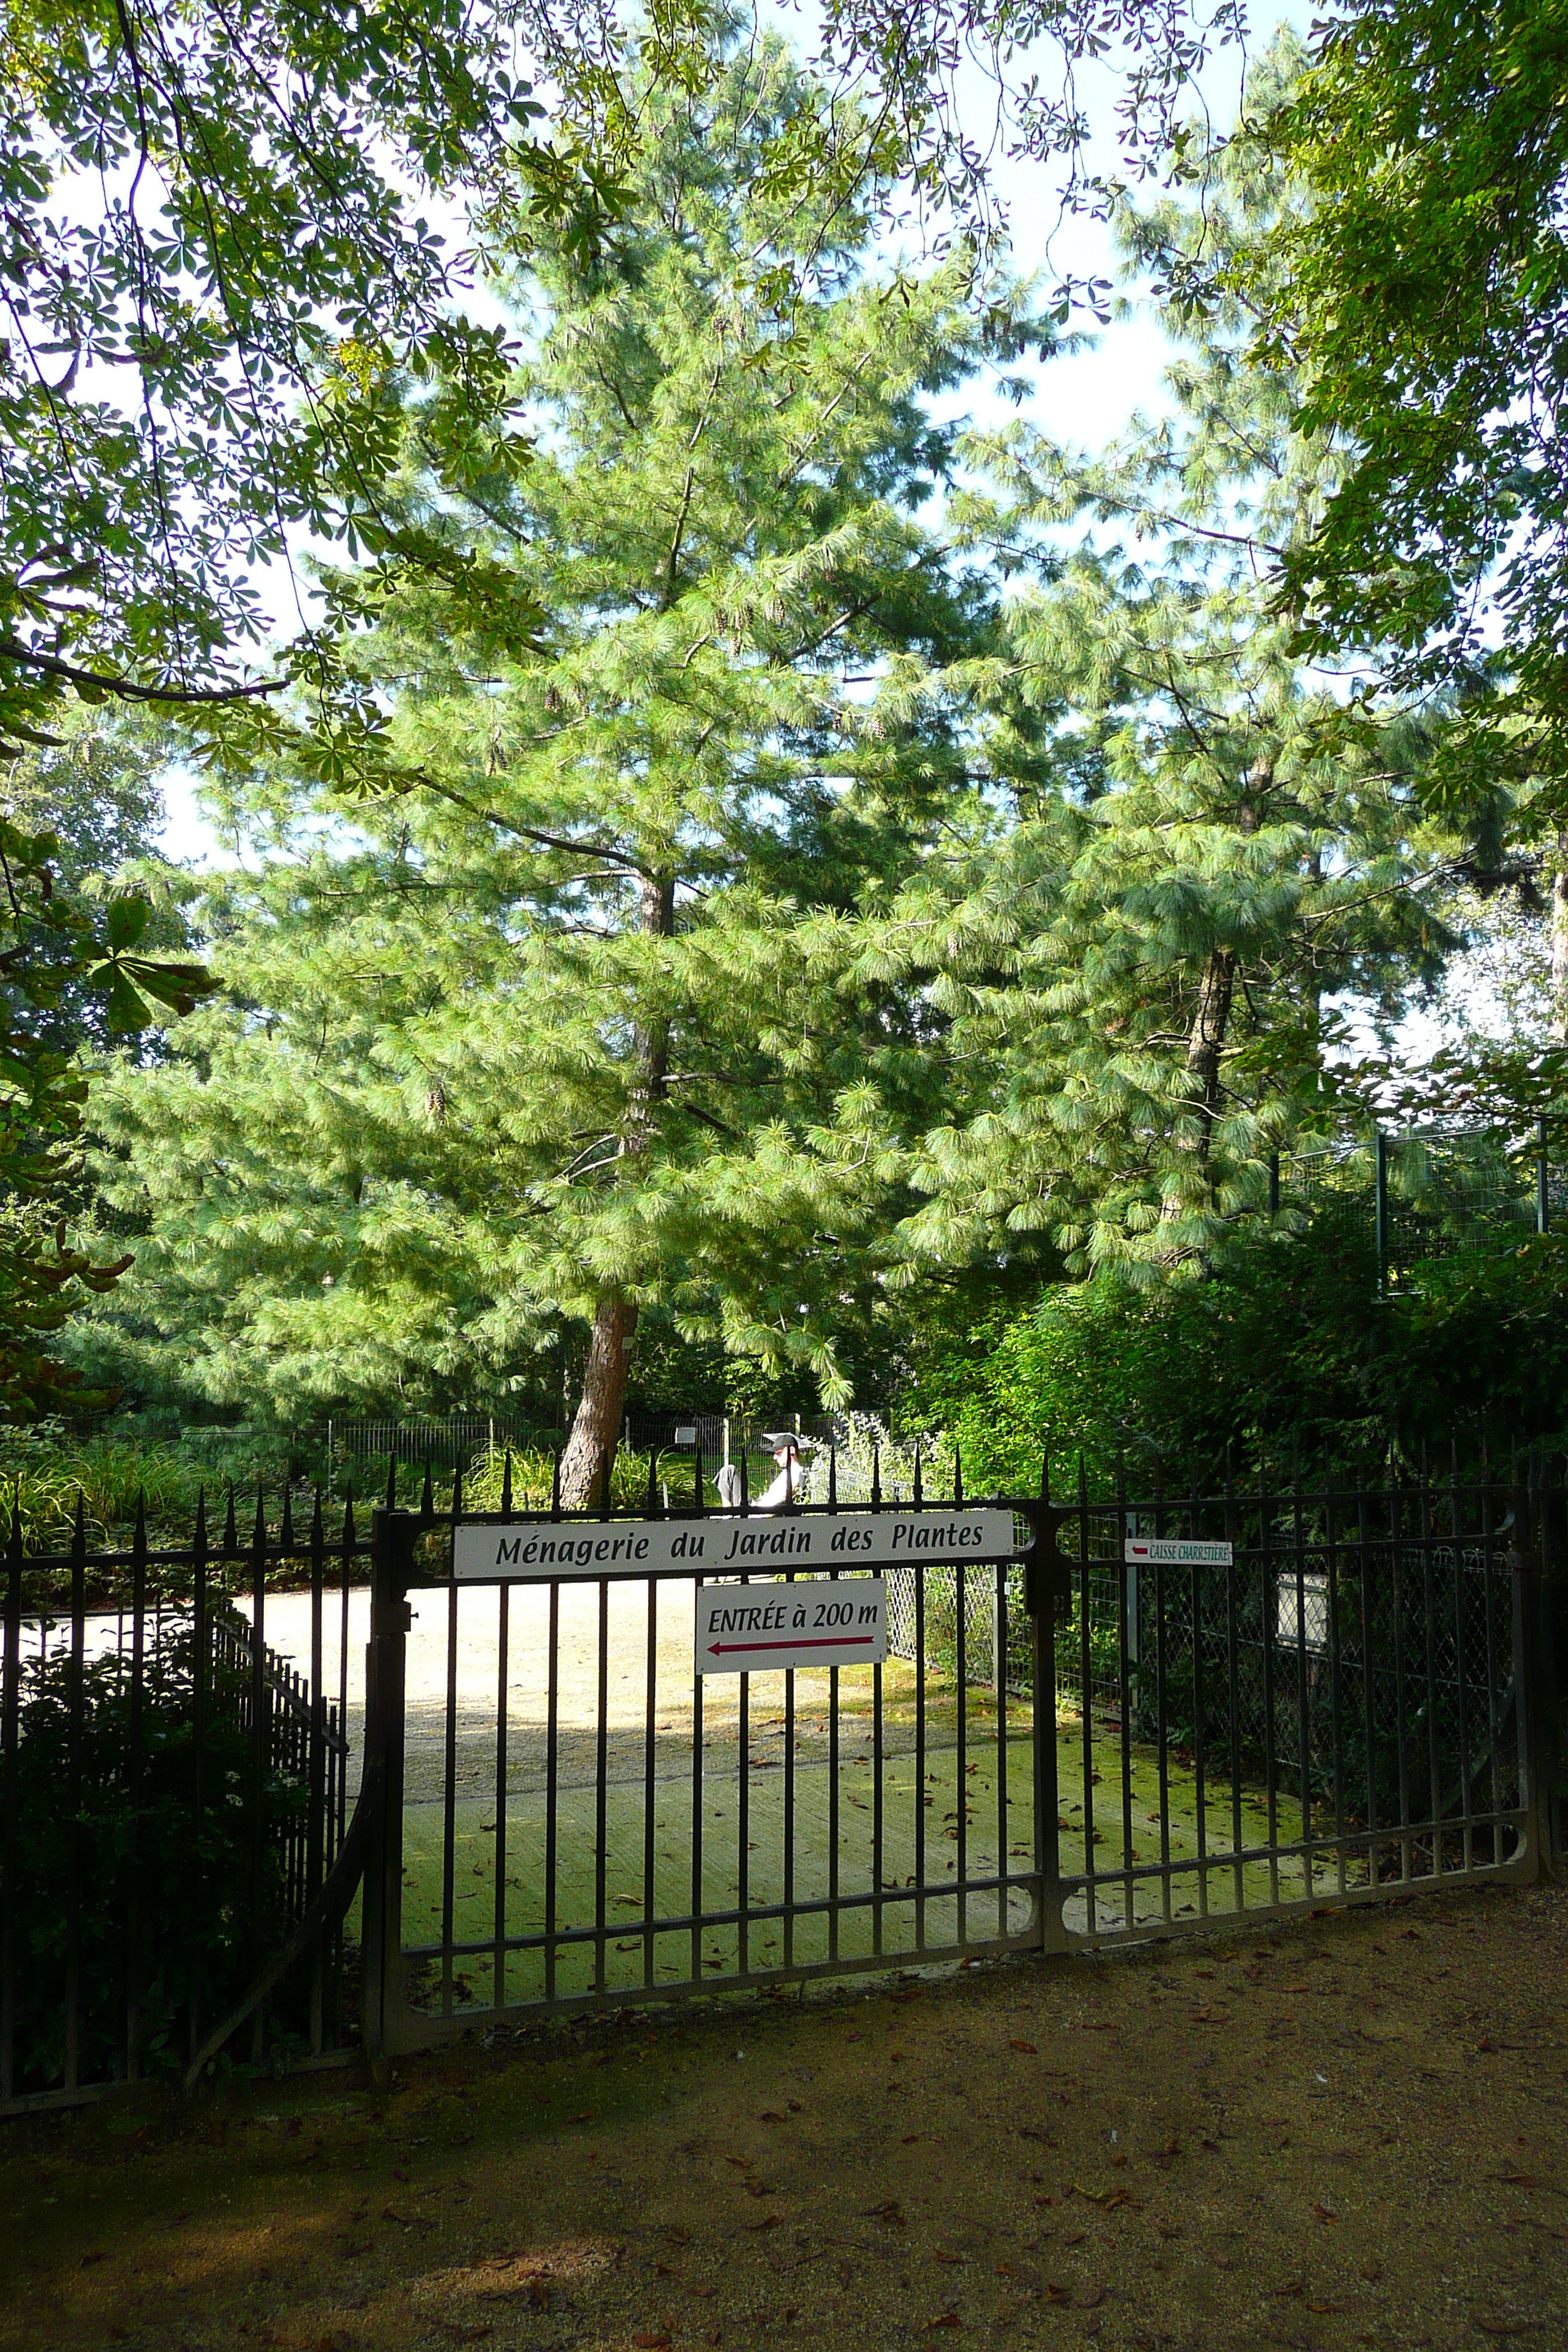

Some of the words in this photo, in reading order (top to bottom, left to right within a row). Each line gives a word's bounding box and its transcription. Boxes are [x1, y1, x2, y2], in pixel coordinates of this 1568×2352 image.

[495, 1532, 649, 1567] Ménagerie
[670, 1532, 706, 1558] du
[723, 1526, 812, 1561] Jardin
[830, 1526, 874, 1552] des
[891, 1522, 984, 1549] Plantes
[1149, 1544, 1177, 1560] CAISSE
[707, 1599, 788, 1633] ENTRÉE
[792, 1603, 807, 1629] à
[813, 1602, 854, 1628] 200
[858, 1605, 878, 1624] m
